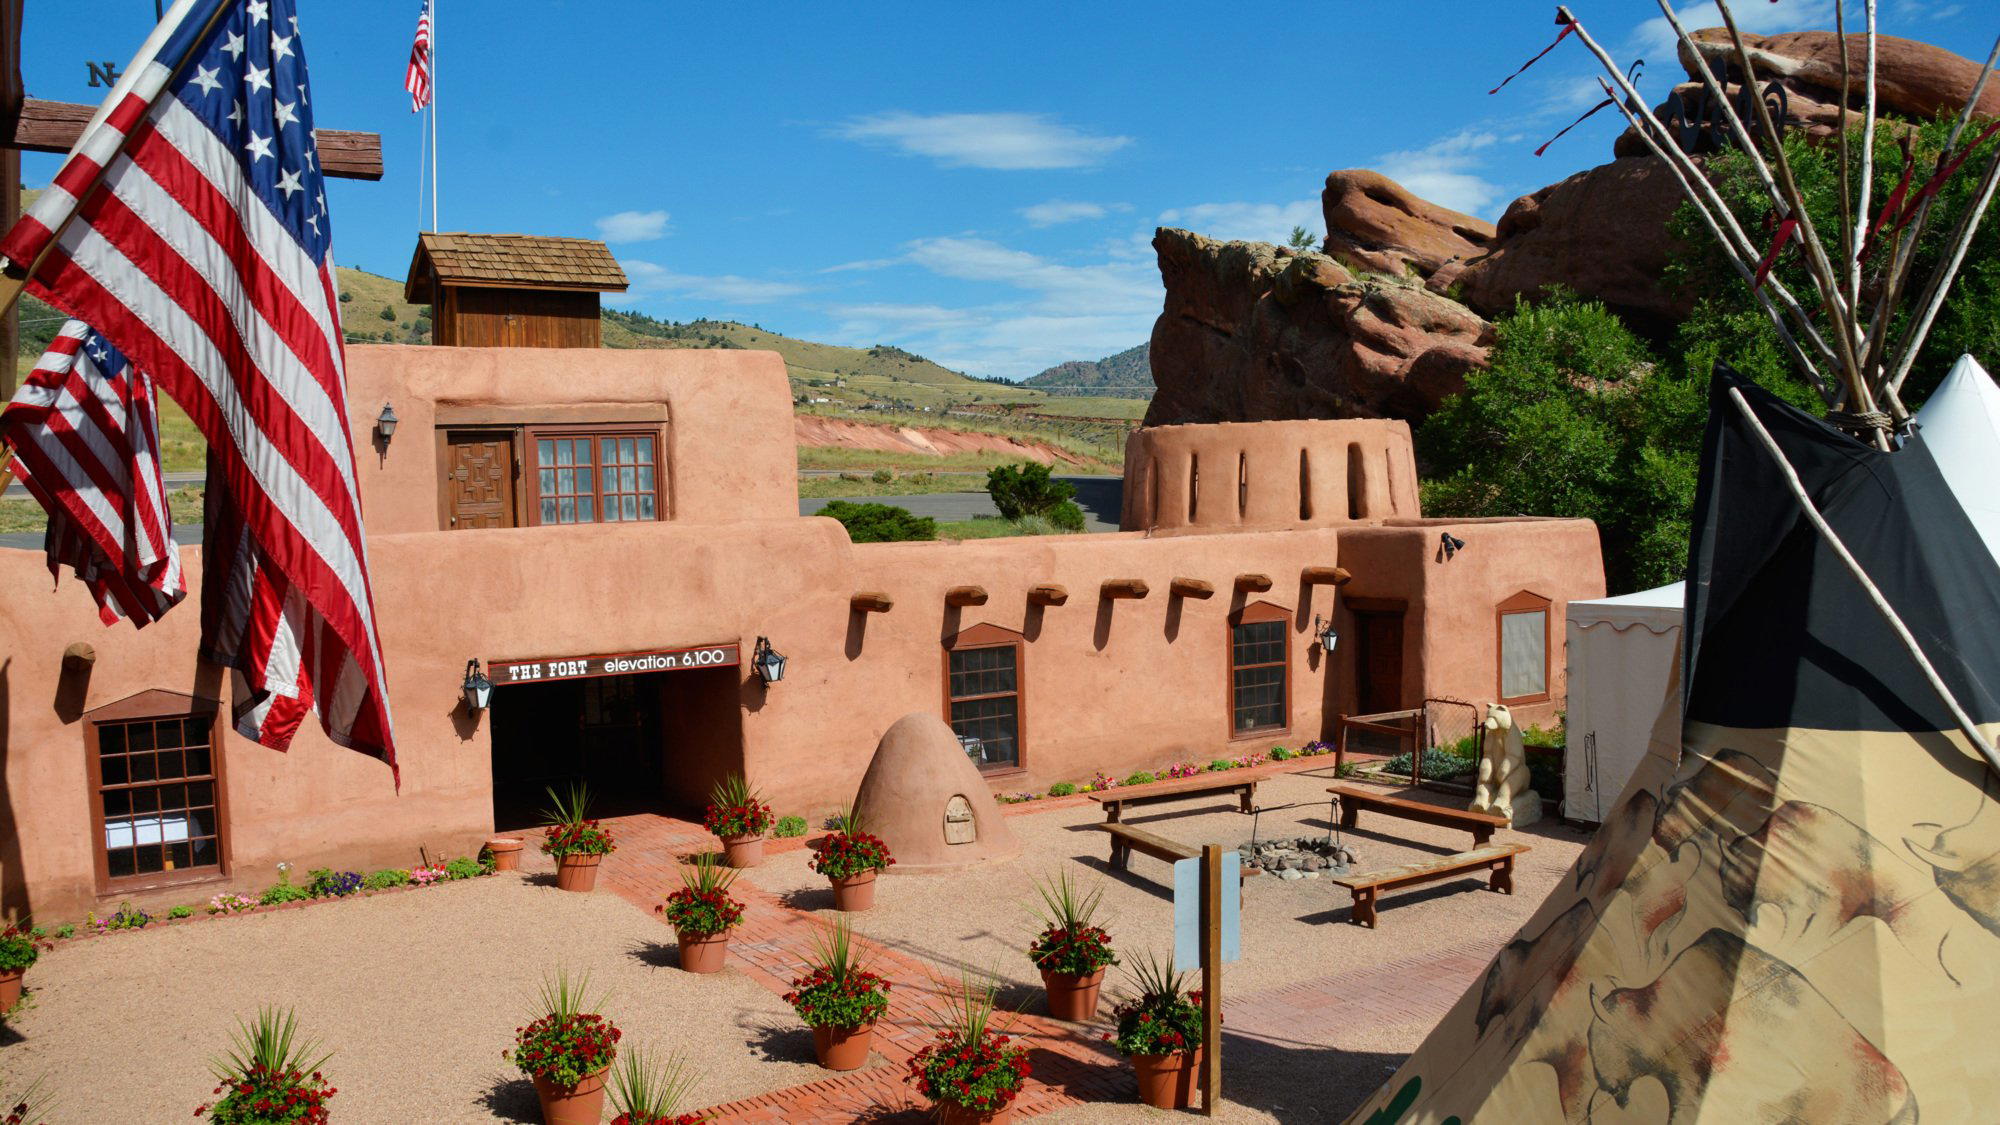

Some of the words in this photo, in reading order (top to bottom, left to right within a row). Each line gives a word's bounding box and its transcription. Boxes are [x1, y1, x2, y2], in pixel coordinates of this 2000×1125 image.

[509, 664, 541, 680] THE
[549, 660, 588, 677] FORT
[604, 655, 676, 672] elevation
[682, 649, 724, 667] 6,100
